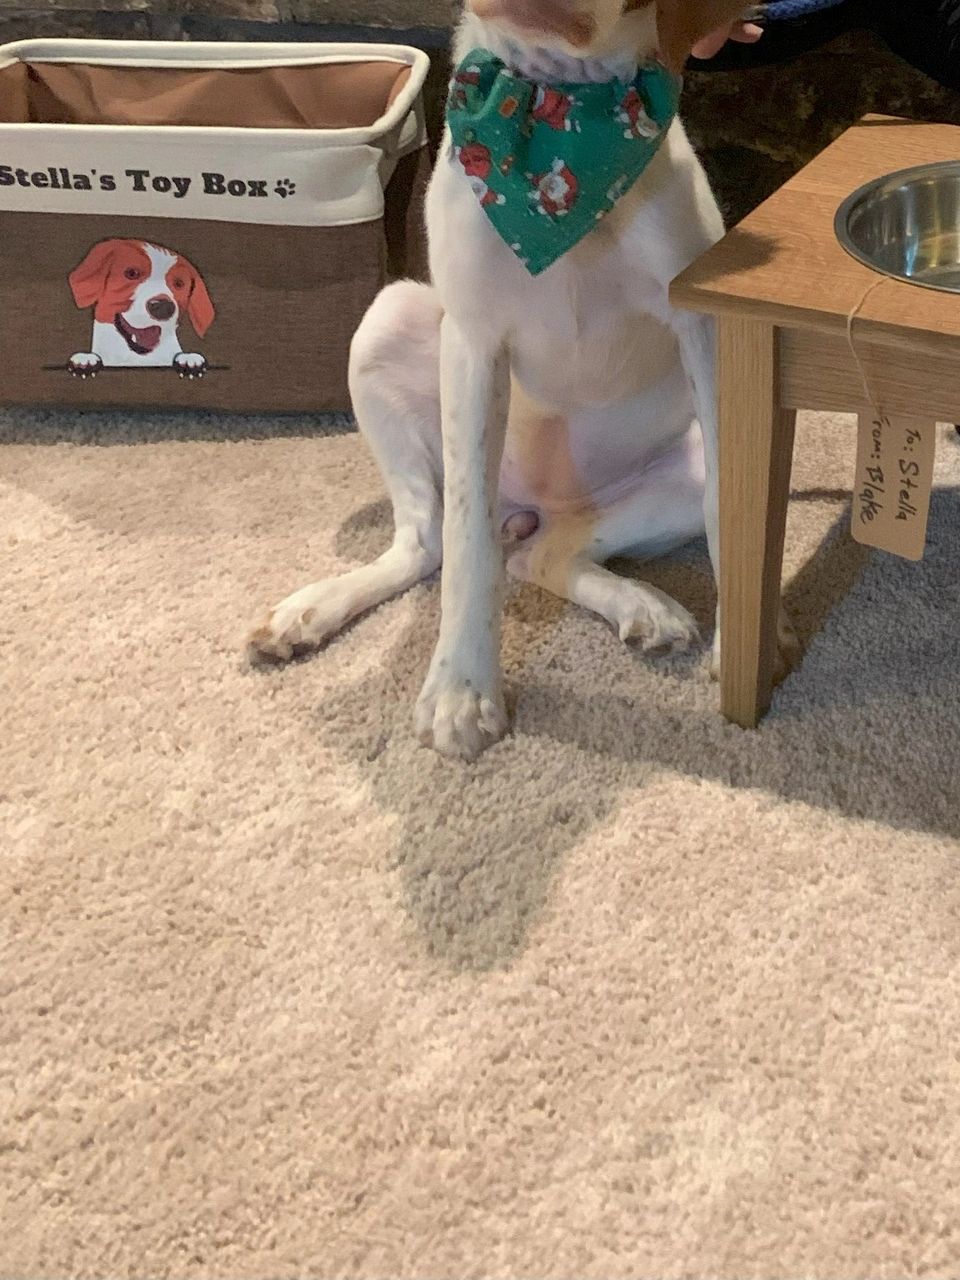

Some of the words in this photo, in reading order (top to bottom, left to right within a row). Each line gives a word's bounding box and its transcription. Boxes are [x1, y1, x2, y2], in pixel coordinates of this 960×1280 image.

[0, 165, 116, 191] Stella's
[125, 169, 191, 198] Toy
[201, 172, 268, 197] Box
[903, 428, 922, 452] To:
[859, 465, 885, 525] Blake
[895, 459, 919, 521] Stella
